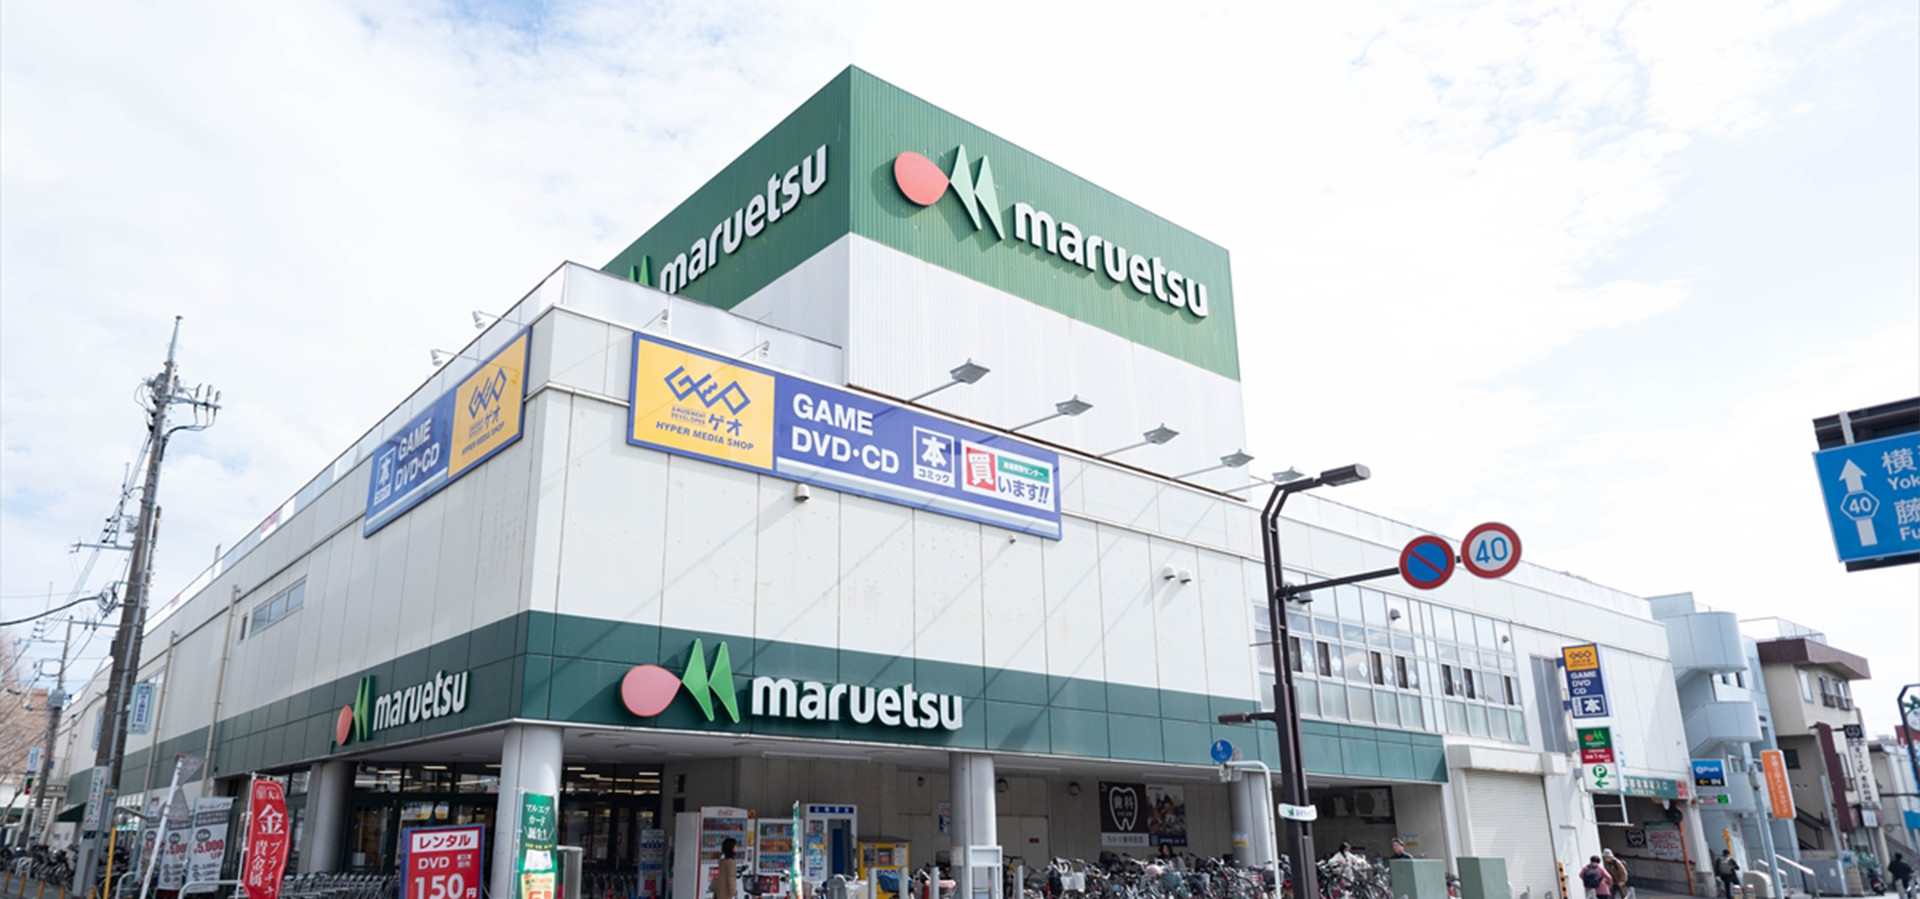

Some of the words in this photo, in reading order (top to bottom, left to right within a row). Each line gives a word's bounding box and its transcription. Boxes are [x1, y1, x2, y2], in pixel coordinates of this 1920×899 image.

[659, 143, 828, 294] maruetsu
[1014, 201, 1209, 318] maruetsu
[708, 413, 743, 436] ゲオ
[793, 393, 874, 436] GAME
[398, 417, 432, 461] GAME
[656, 421, 690, 436] HYPER
[693, 430, 724, 444] MEDIA
[727, 438, 754, 450] SHOP
[921, 436, 947, 467] 本
[1881, 444, 1920, 475] 横
[918, 468, 950, 483] コミック
[1849, 497, 1872, 514] 40
[1475, 536, 1508, 563] 40
[1570, 670, 1597, 679] GAME
[1572, 679, 1592, 687] DVD
[373, 670, 469, 731] maruetsu
[752, 675, 963, 730] maruetsu
[1584, 698, 1601, 713] 本
[257, 804, 284, 834] 金
[525, 804, 550, 815] マルエツ
[528, 815, 546, 826] カード
[419, 834, 471, 850] レンタル
[210, 852, 223, 860] UP
[264, 839, 282, 898] プラチナ
[418, 856, 449, 871] DVD
[415, 872, 464, 899] 150
